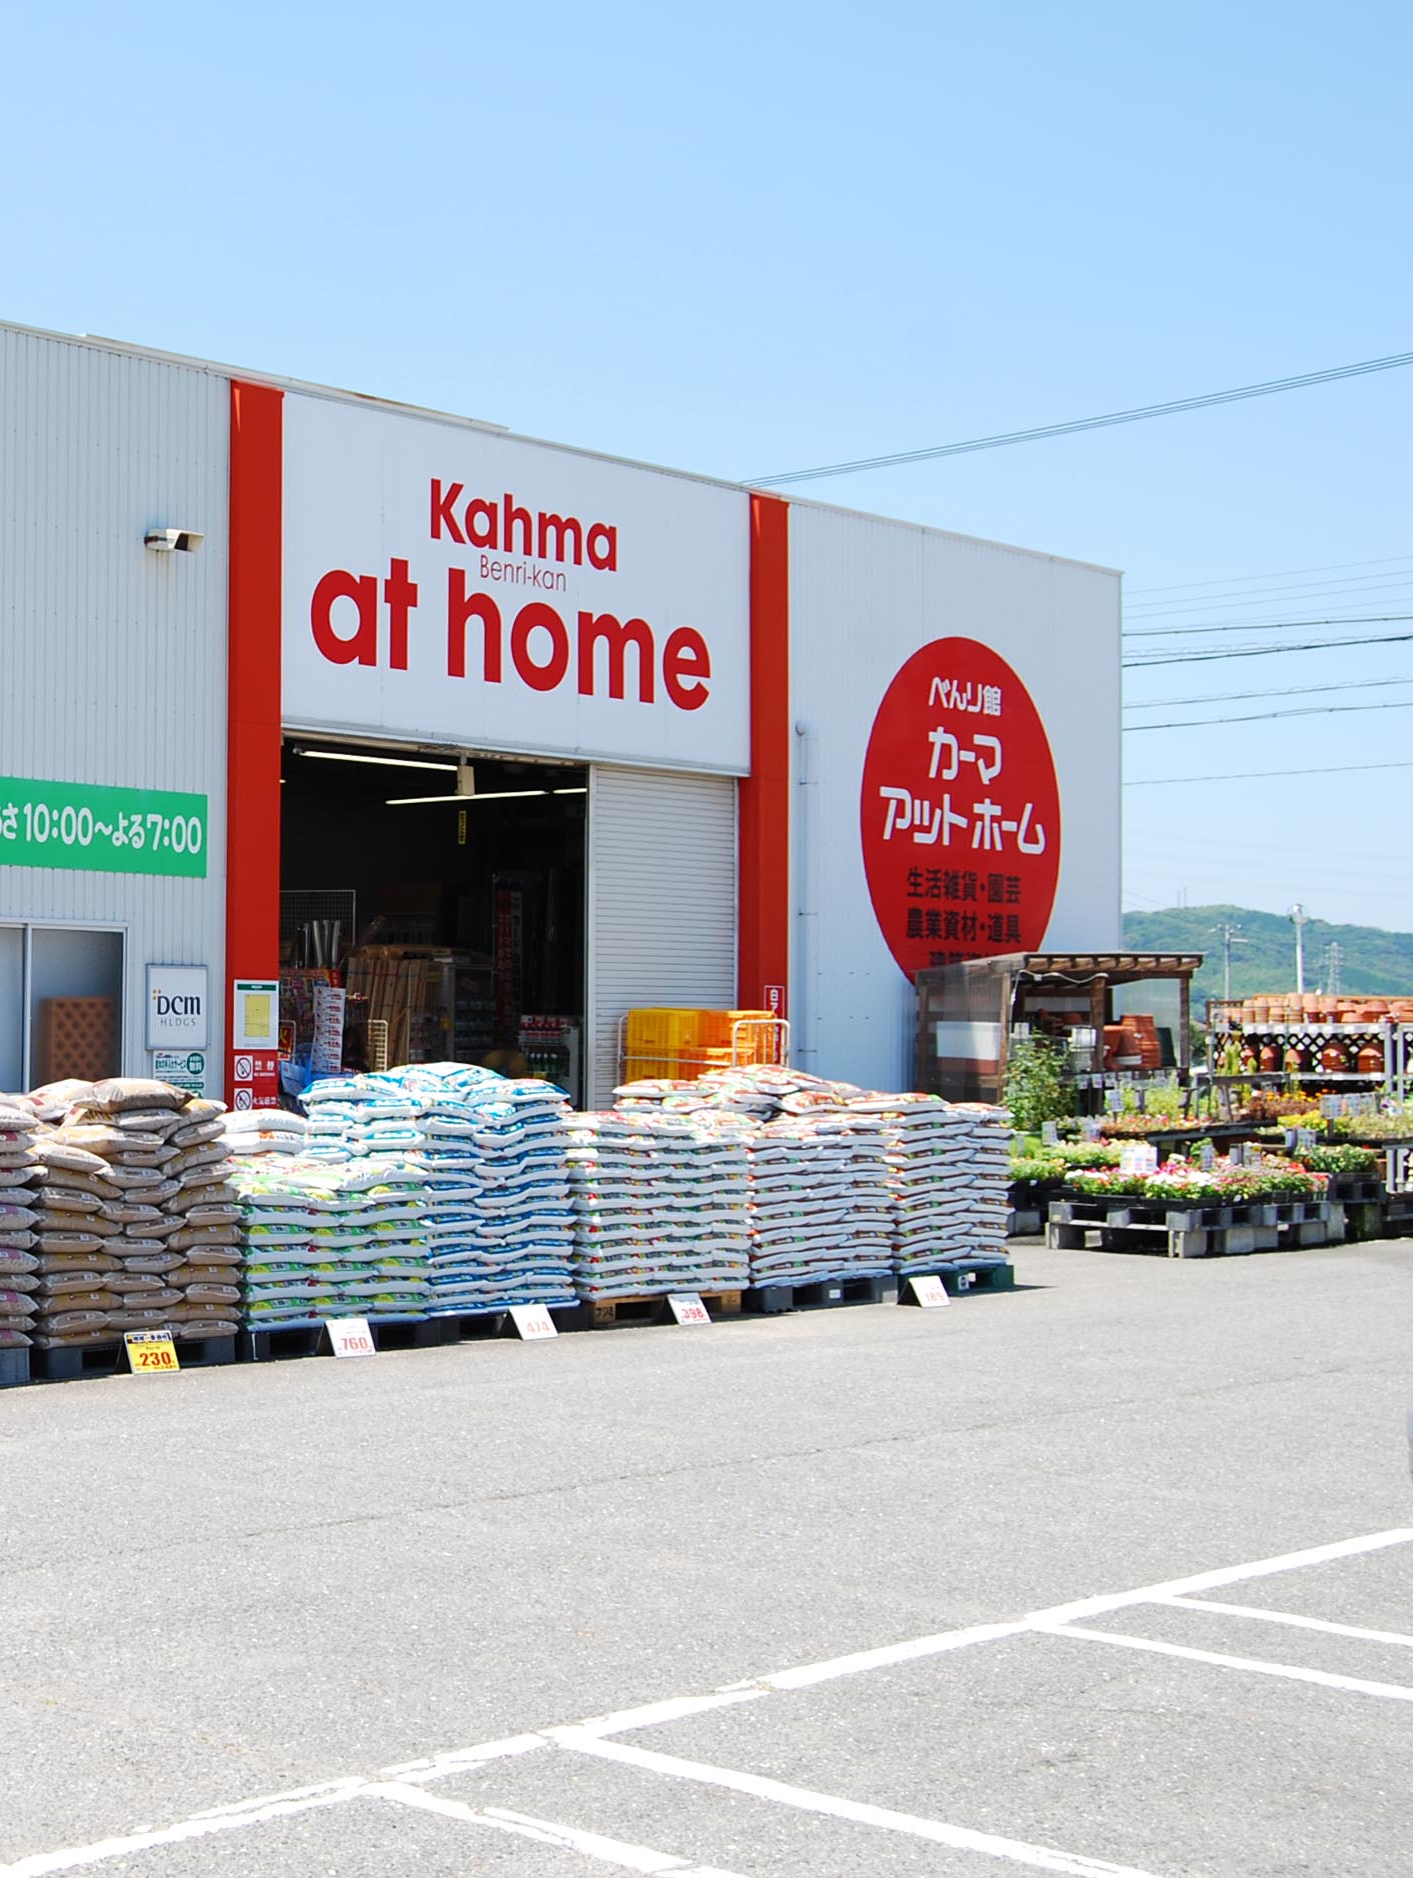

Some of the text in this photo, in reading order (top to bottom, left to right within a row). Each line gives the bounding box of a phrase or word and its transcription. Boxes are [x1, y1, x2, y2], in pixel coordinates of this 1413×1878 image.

[430, 478, 618, 572] Kahma
[479, 554, 567, 592] Benri-kan
[310, 557, 711, 711] at home
[928, 676, 1002, 717] べんり館
[928, 726, 1003, 785] カーマ
[140, 1351, 172, 1367] 230
[341, 1336, 368, 1351] 760
